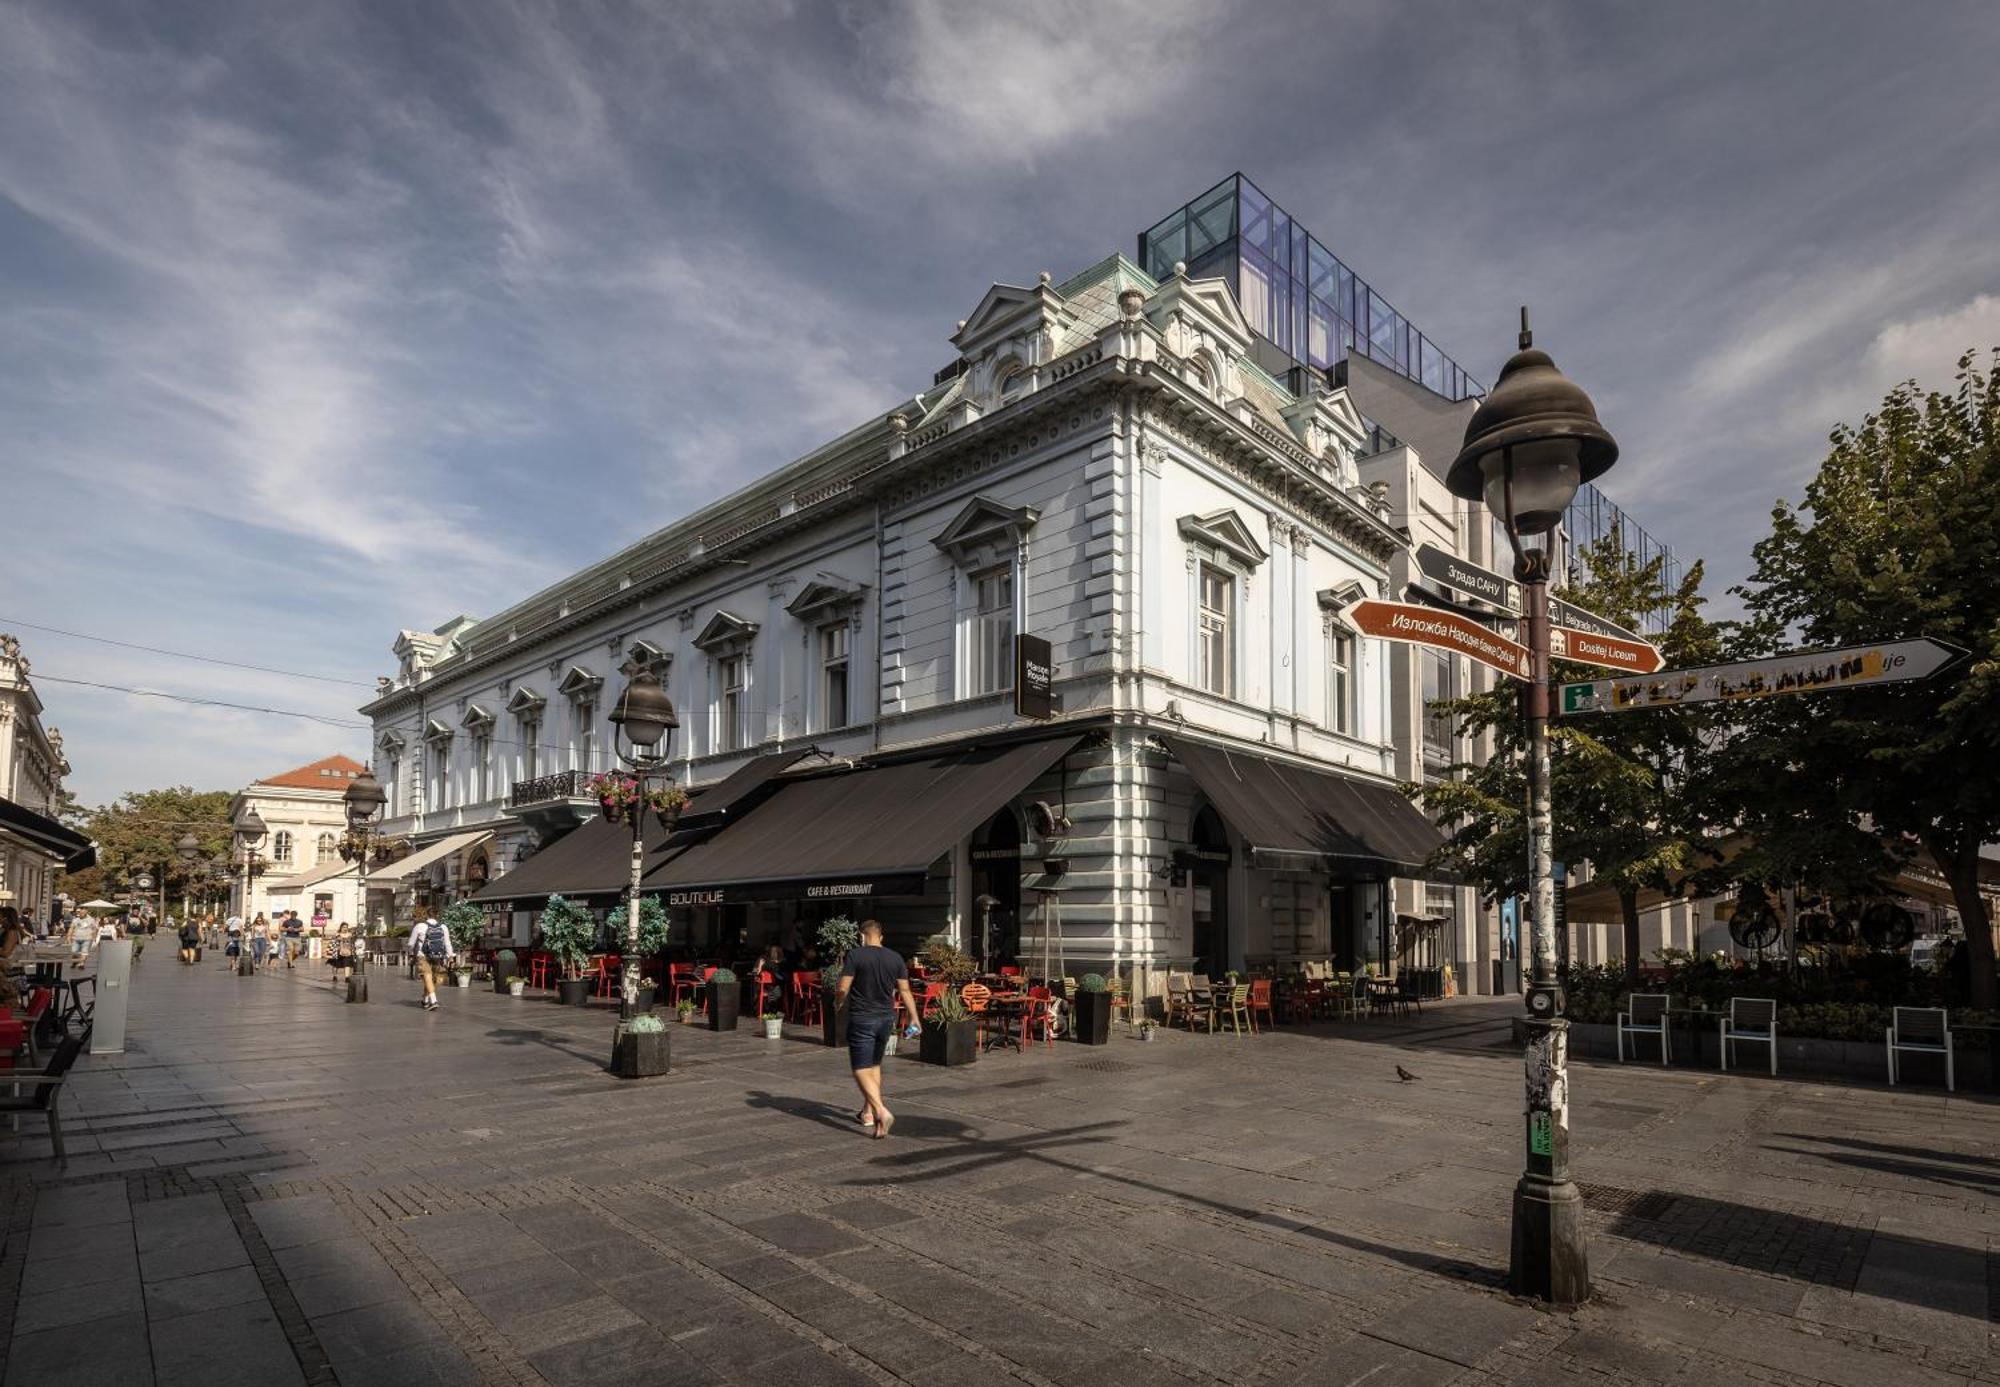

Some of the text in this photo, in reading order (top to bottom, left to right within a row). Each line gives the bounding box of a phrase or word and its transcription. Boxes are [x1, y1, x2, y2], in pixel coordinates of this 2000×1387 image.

[1448, 565, 1500, 596] Зграда САНУ
[1392, 613, 1447, 637] Изложба
[1579, 640, 1637, 662] Dositej Liceum
[670, 890, 724, 905] BOUTIQUE
[807, 884, 873, 897] CAFE & RESTAURANT
